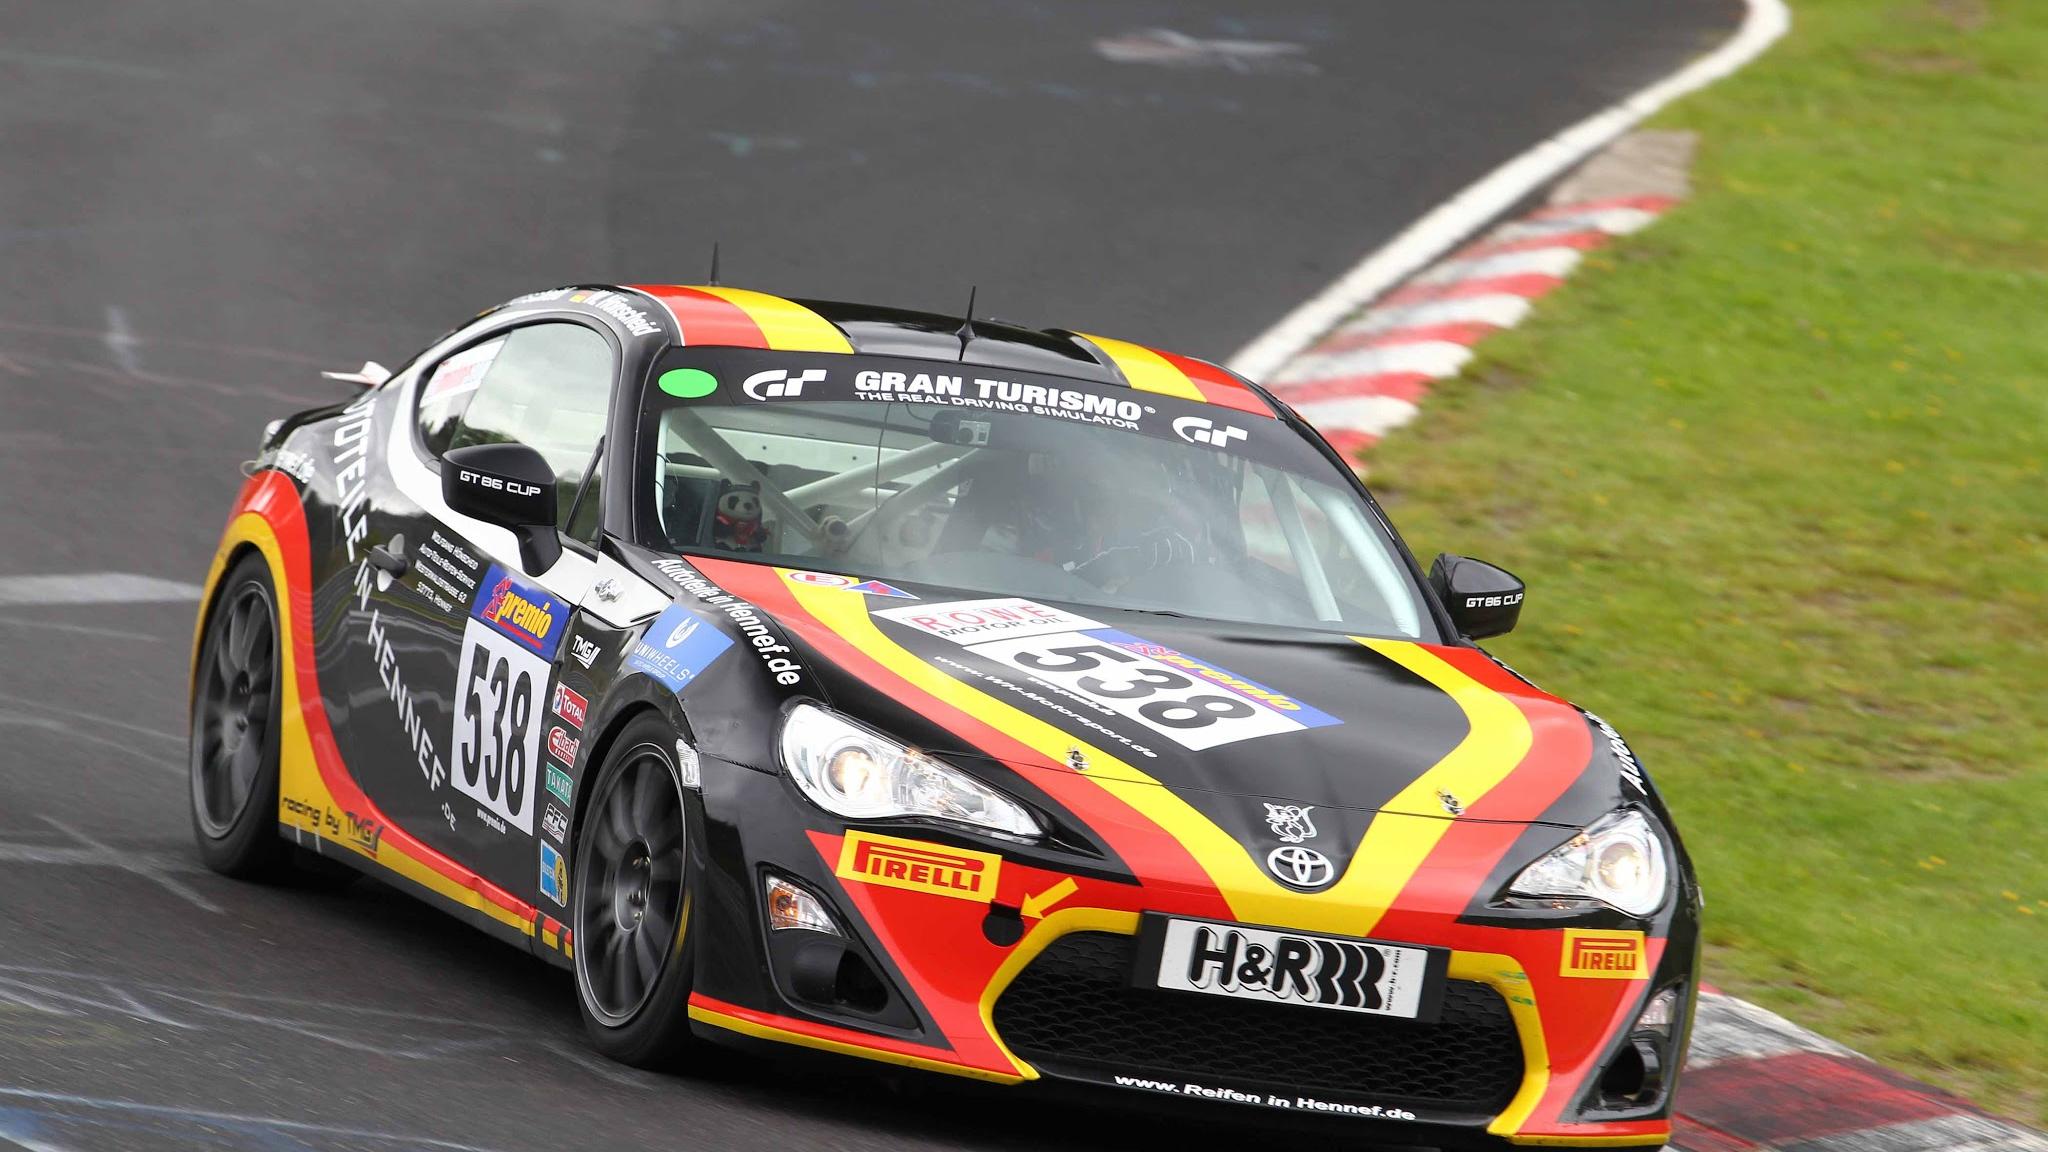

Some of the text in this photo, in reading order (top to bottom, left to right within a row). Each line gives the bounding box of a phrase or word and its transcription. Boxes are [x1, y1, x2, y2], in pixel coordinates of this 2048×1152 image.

[855, 370, 1142, 421] GRAN TURISMO
[855, 391, 1139, 431] THE REAL DRIVING SIMULATOR
[506, 482, 541, 496] CUP
[494, 591, 552, 639] premio
[911, 606, 1056, 630] ROWE
[1504, 593, 1523, 605] CUP
[721, 599, 802, 686] Hennef.de
[938, 620, 1026, 637] MOTOR
[368, 609, 445, 791] HENNEF
[1014, 645, 1256, 729] 538
[461, 643, 532, 816] 538
[326, 806, 340, 835] by
[853, 840, 985, 892] PIRELLI
[1570, 937, 1637, 970] PIRELLI
[1267, 1095, 1290, 1109] in
[1296, 1097, 1416, 1121] Hennef.de
